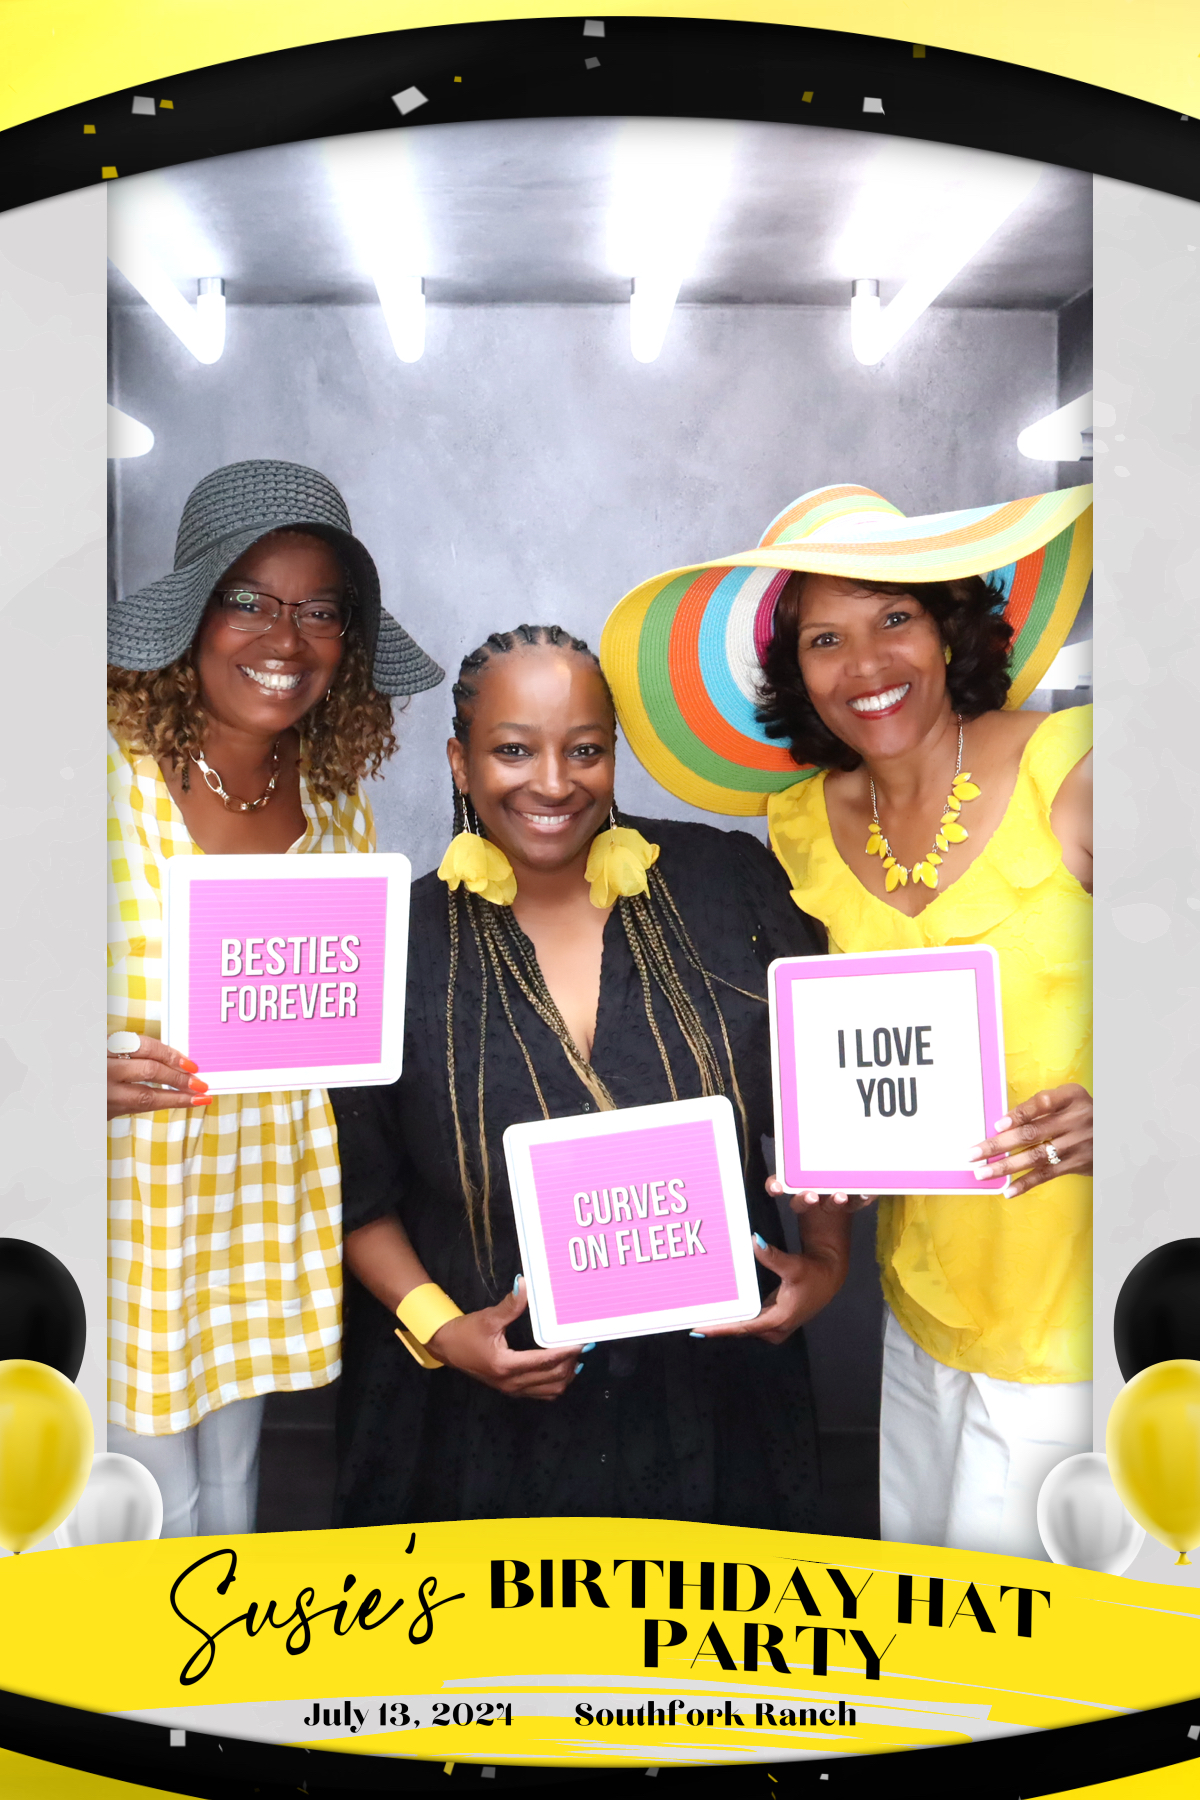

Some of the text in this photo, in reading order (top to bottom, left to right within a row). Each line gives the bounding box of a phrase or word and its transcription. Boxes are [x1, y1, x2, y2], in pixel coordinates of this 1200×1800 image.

[220, 934, 361, 977] BESTIES
[220, 981, 359, 1023] FOREVER
[837, 1025, 934, 1069] I LOVE
[856, 1077, 918, 1118] YOU
[572, 1178, 688, 1227] CURVES
[567, 1219, 707, 1272] ON FLEEK
